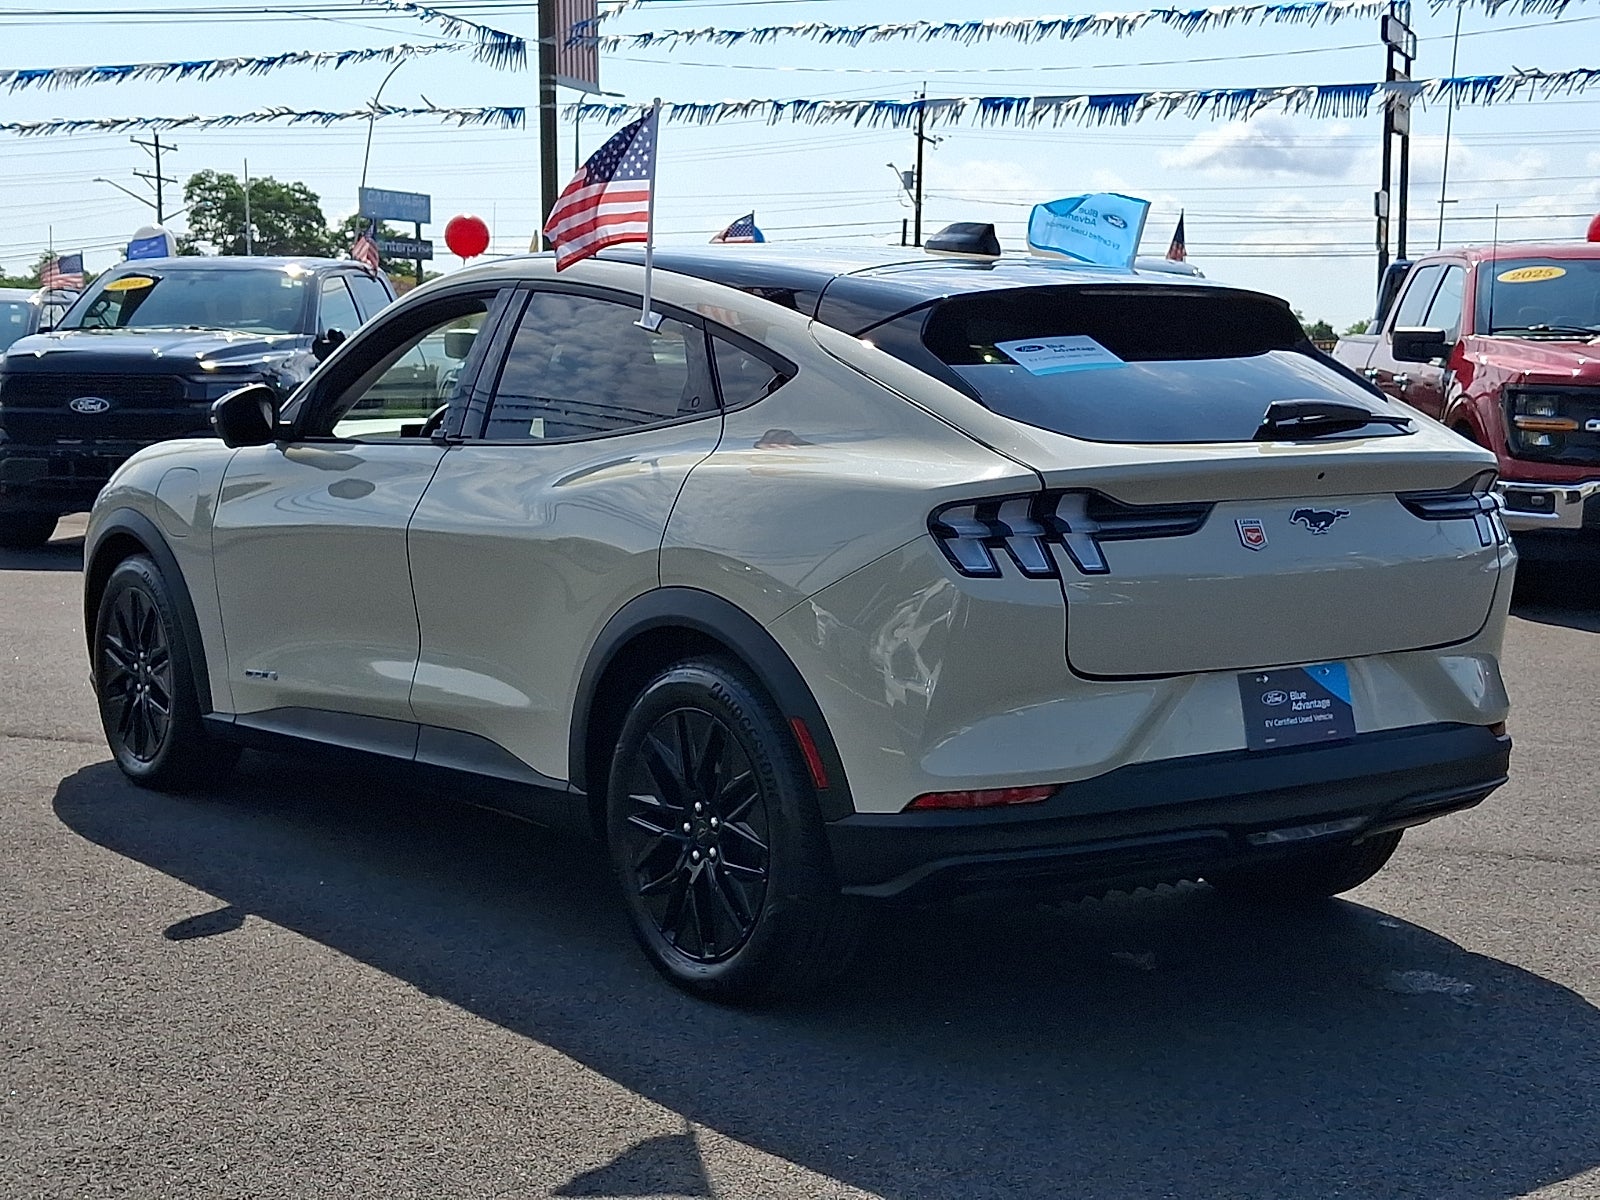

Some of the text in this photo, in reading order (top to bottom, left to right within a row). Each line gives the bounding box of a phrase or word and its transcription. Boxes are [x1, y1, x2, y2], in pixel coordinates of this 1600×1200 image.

[1509, 269, 1553, 281] 2025
[1289, 690, 1307, 701] Blue
[1291, 699, 1332, 711] Advantage
[1264, 713, 1334, 728] EV Certified Used Vehicle
